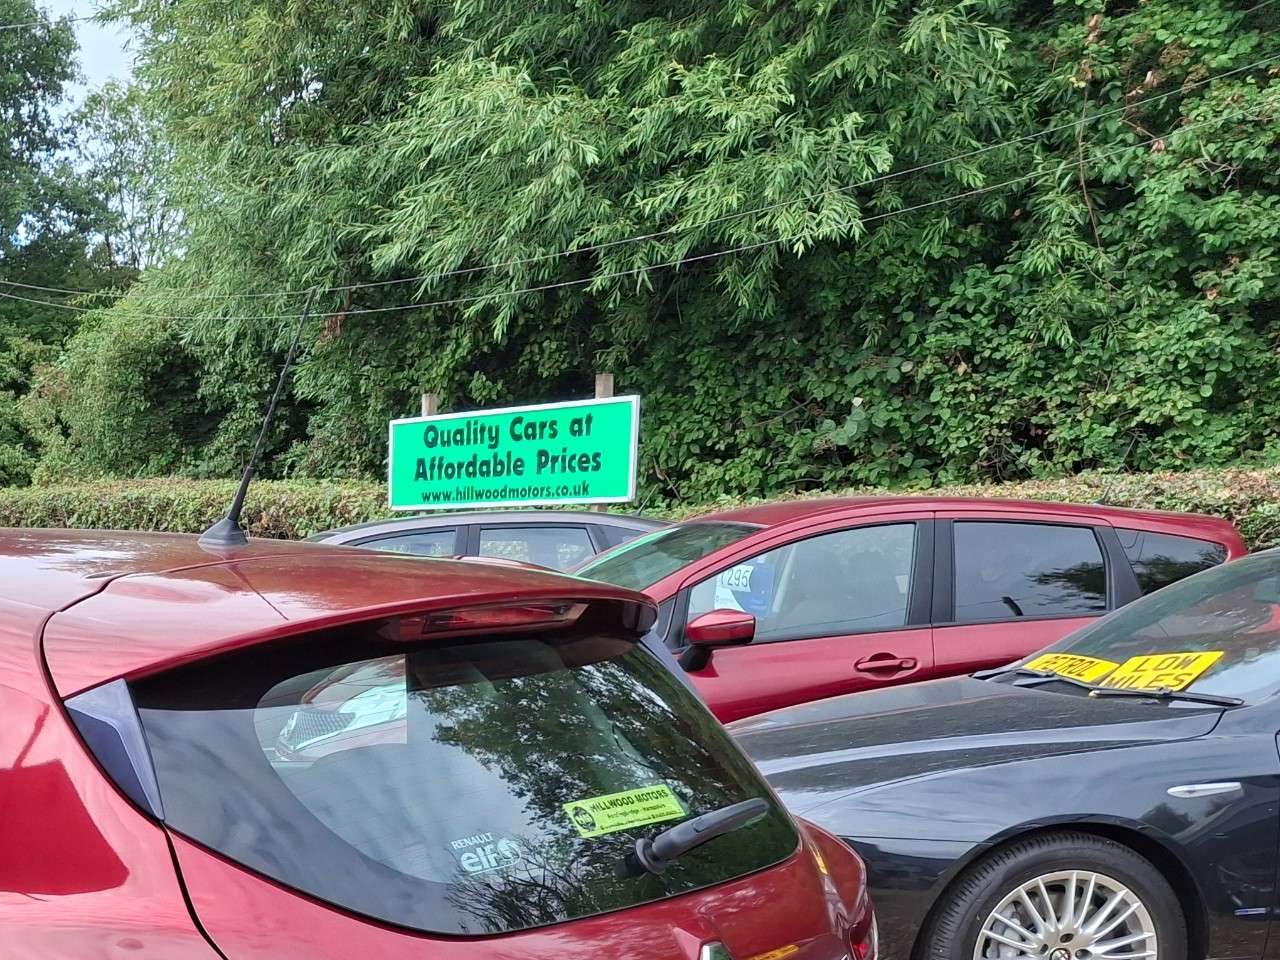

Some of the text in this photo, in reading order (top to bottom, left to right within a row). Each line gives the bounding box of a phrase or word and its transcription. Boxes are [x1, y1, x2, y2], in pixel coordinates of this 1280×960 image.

[423, 413, 593, 449] Quality Cars at
[414, 447, 602, 482] Affordable Prices
[422, 480, 590, 503] www.hillwoodmotors.co.uk
[1036, 655, 1101, 677] PETROL
[1132, 654, 1202, 673] LOW
[1102, 672, 1193, 690] MILES
[590, 796, 635, 813] HILLWOOD
[635, 789, 669, 804] MOTORS
[450, 832, 494, 850] RENAULT
